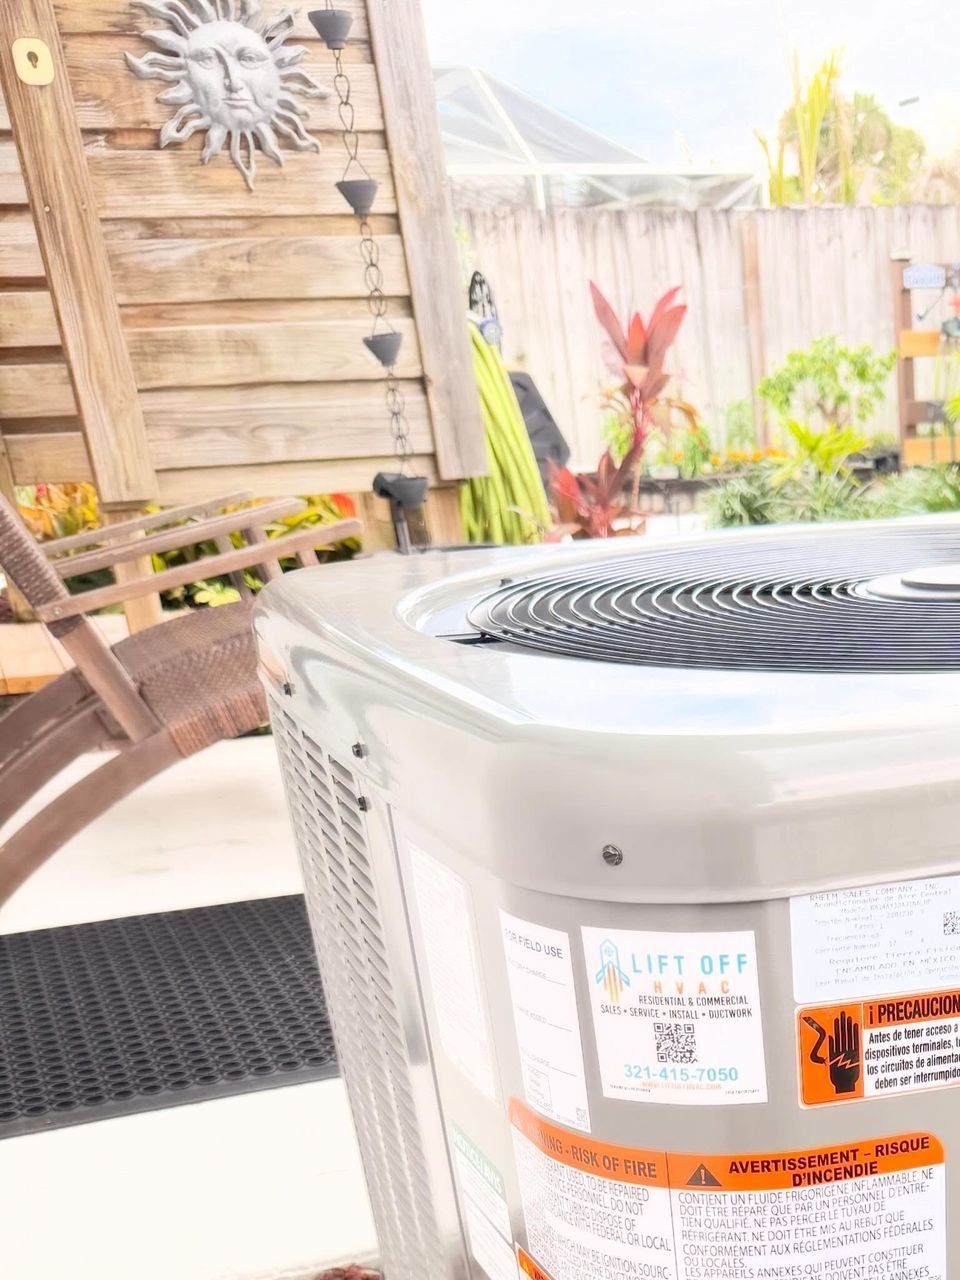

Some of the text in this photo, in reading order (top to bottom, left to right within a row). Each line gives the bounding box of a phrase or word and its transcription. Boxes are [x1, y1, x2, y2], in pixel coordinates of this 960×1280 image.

[842, 889, 871, 899] SALES
[519, 933, 542, 953] FIELD
[544, 944, 564, 960] USE
[631, 953, 749, 975] LIFT OFF
[600, 1004, 753, 1019] SALES SERVICE INSTALL DUCTWORK
[638, 995, 749, 1006] RESIDENTIAL & COMMERCIAL
[869, 1032, 891, 1045] Antes
[892, 1029, 902, 1041] de
[904, 1027, 924, 1040] tener
[925, 1022, 952, 1037] acceso
[953, 1023, 959, 1033] a
[864, 1041, 910, 1062] dispositivos
[912, 1038, 954, 1055] terminales,
[624, 1064, 739, 1082] 321-415-7050
[867, 1063, 879, 1076] los
[880, 1058, 914, 1075] circuitos
[915, 1056, 925, 1069] de
[874, 1075, 899, 1090] deben
[900, 1073, 912, 1086] ser
[571, 1144, 600, 1168] RISK
[602, 1155, 620, 1173] OF
[624, 1159, 658, 1179] FIRE
[728, 1136, 930, 1174] AVERTISSEMENT RISQUE
[792, 1161, 879, 1187] D'INCENDIE
[585, 1174, 650, 1202] TO BE REPAIRED
[678, 1168, 934, 1206] CONTIENT UN FLUIDE NE
[610, 1198, 645, 1216] DO NOT
[679, 1206, 702, 1217] DOIT
[770, 1203, 791, 1217] QUE
[794, 1201, 813, 1214] PAR
[815, 1198, 830, 1211] UN
[832, 1189, 886, 1208] PERSONNEL
[680, 1200, 886, 1229] TIEN NE PAS PERCER LE TUYAU DE
[591, 1208, 637, 1232] DISPOSE OF
[752, 1230, 765, 1242] NE
[767, 1228, 792, 1241] DOIT
[819, 1221, 837, 1235] MIS
[839, 1219, 852, 1231] AU
[854, 1214, 883, 1229] REBUT
[885, 1210, 905, 1224] QUE
[592, 1222, 672, 1252] FEDERAL OR LOCAL
[682, 1243, 768, 1257] CONFORMÉMENT
[770, 1242, 791, 1255] AUX
[684, 1243, 924, 1279] LES APPAREILS ANNEXES QUI PEUVENT CONSTITUER
[602, 1253, 672, 1280] IGNITION SOURC-
[684, 1256, 747, 1269] OU LOCALES.
[868, 1263, 885, 1275] PAS
